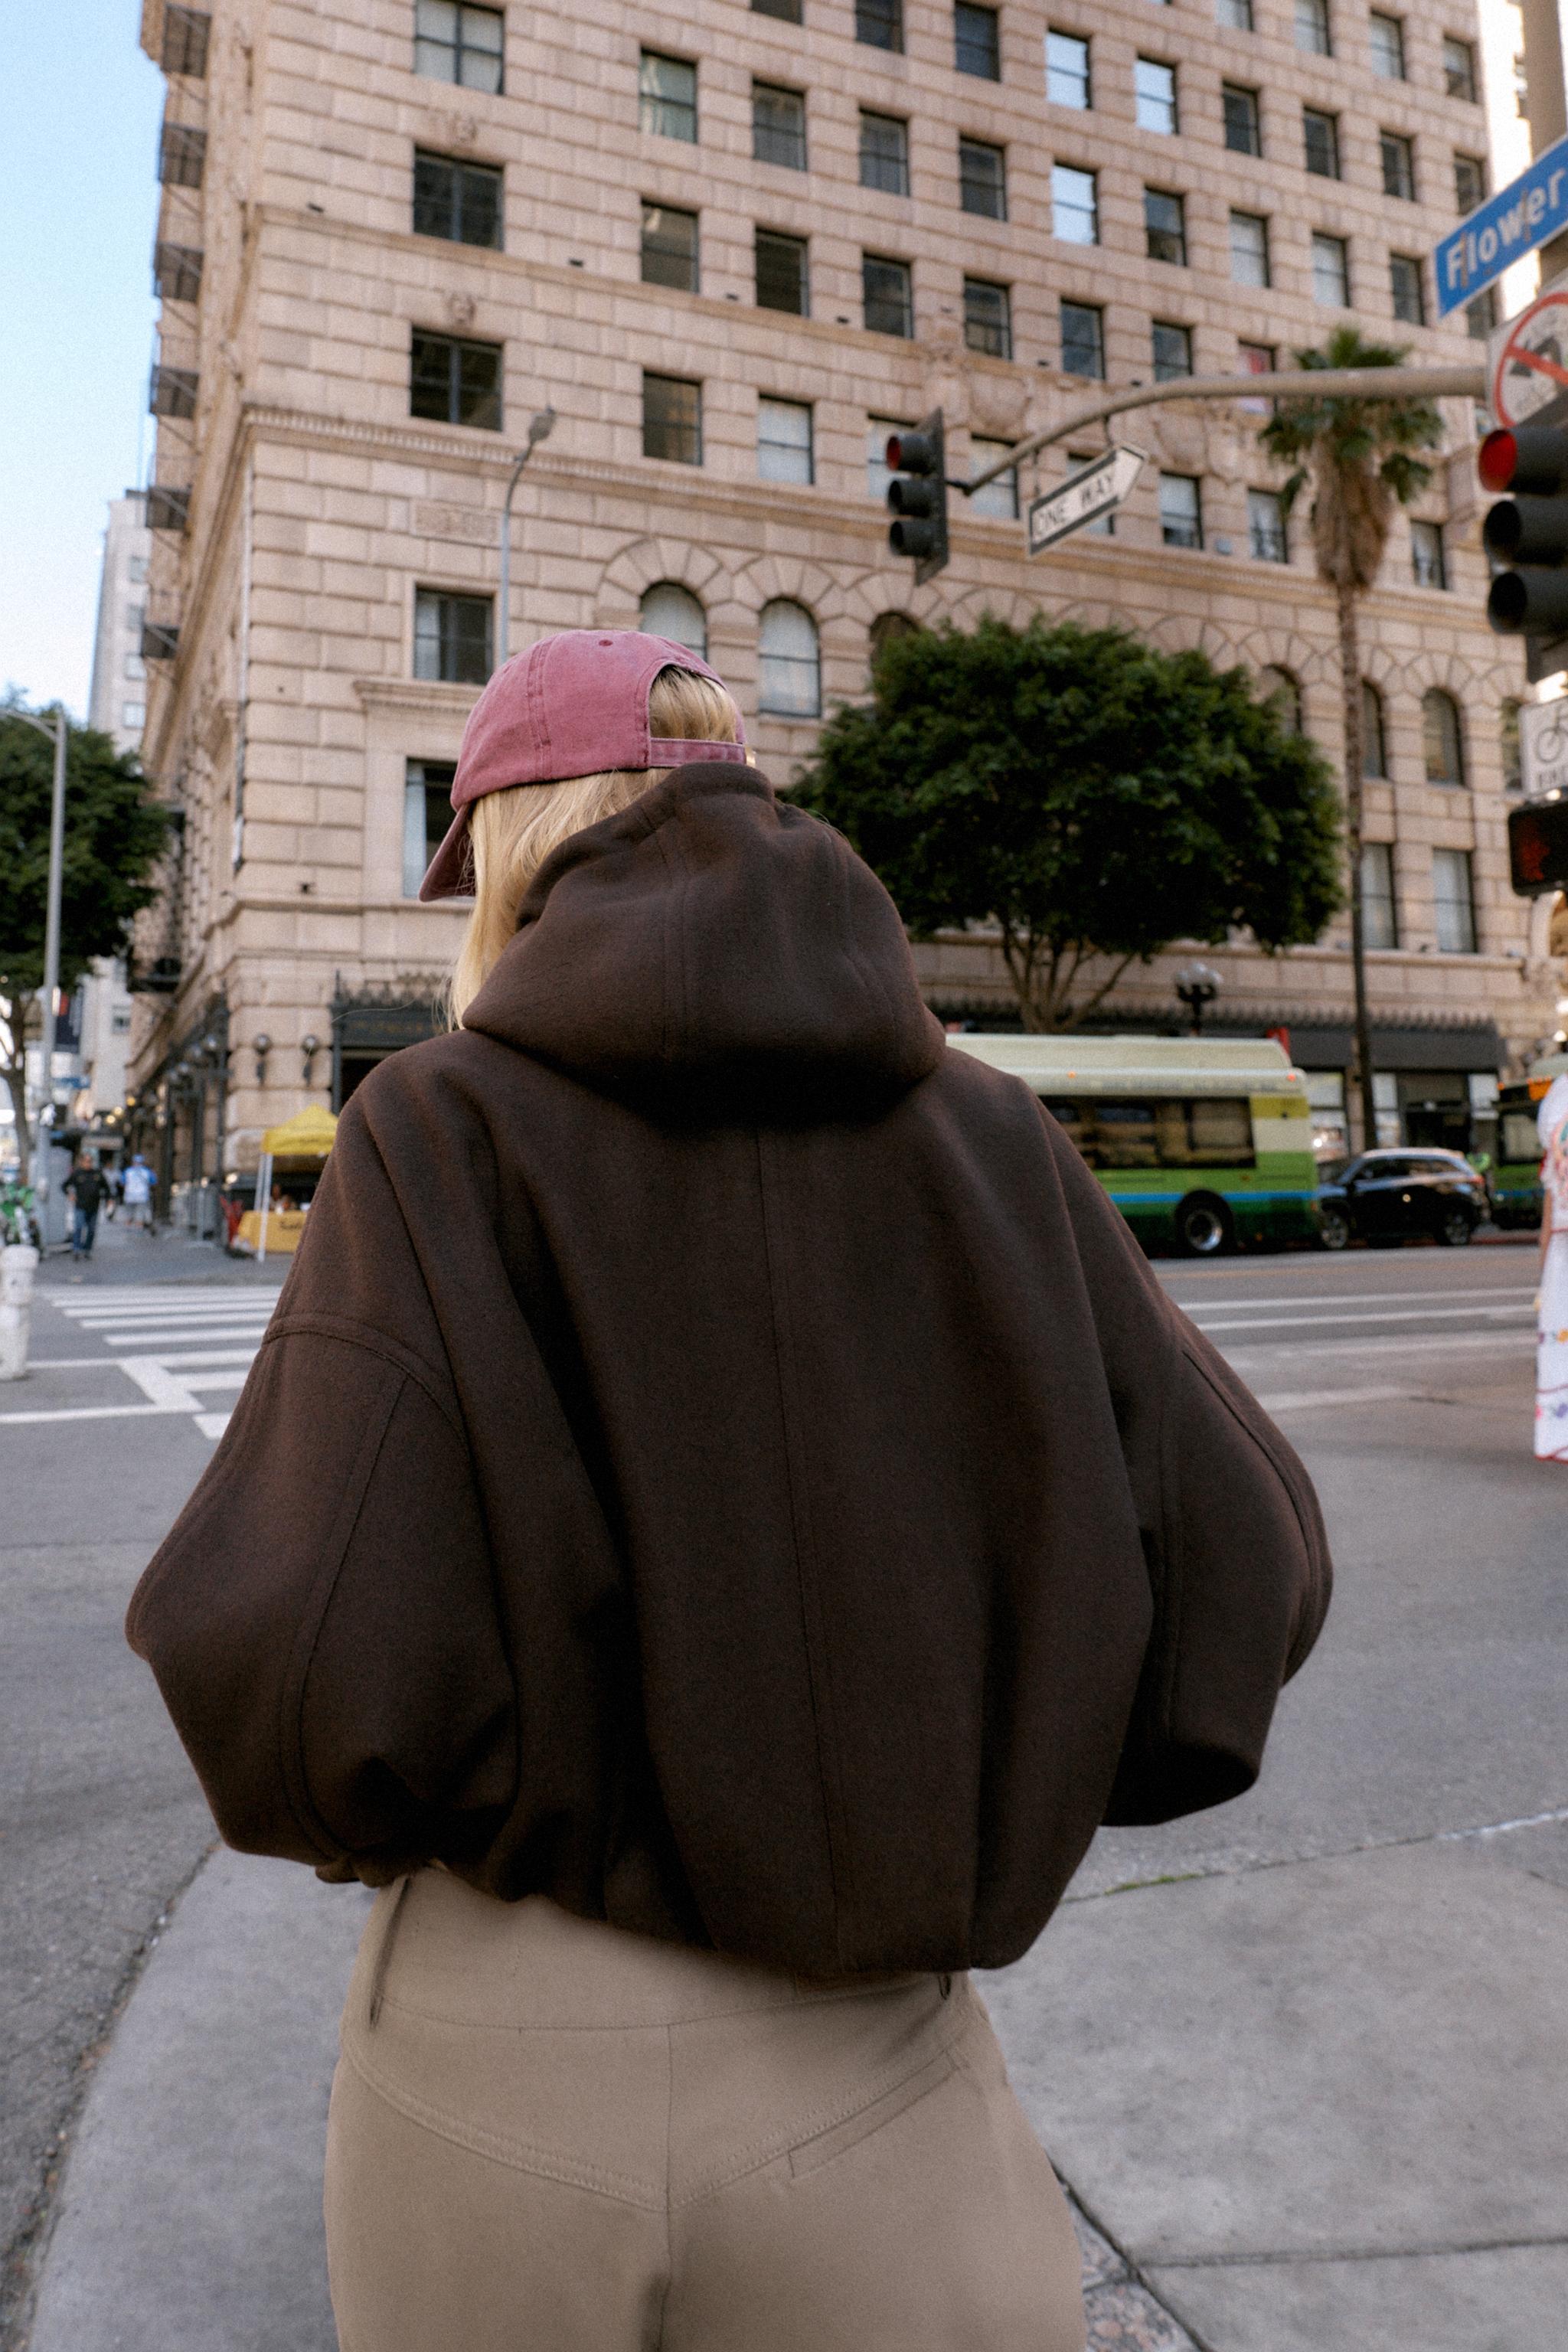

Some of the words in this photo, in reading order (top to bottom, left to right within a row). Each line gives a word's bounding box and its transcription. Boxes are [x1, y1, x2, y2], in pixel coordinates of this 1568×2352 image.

[1447, 167, 1565, 289] Flower
[1034, 498, 1068, 537] ONE
[1080, 472, 1113, 510] WAY
